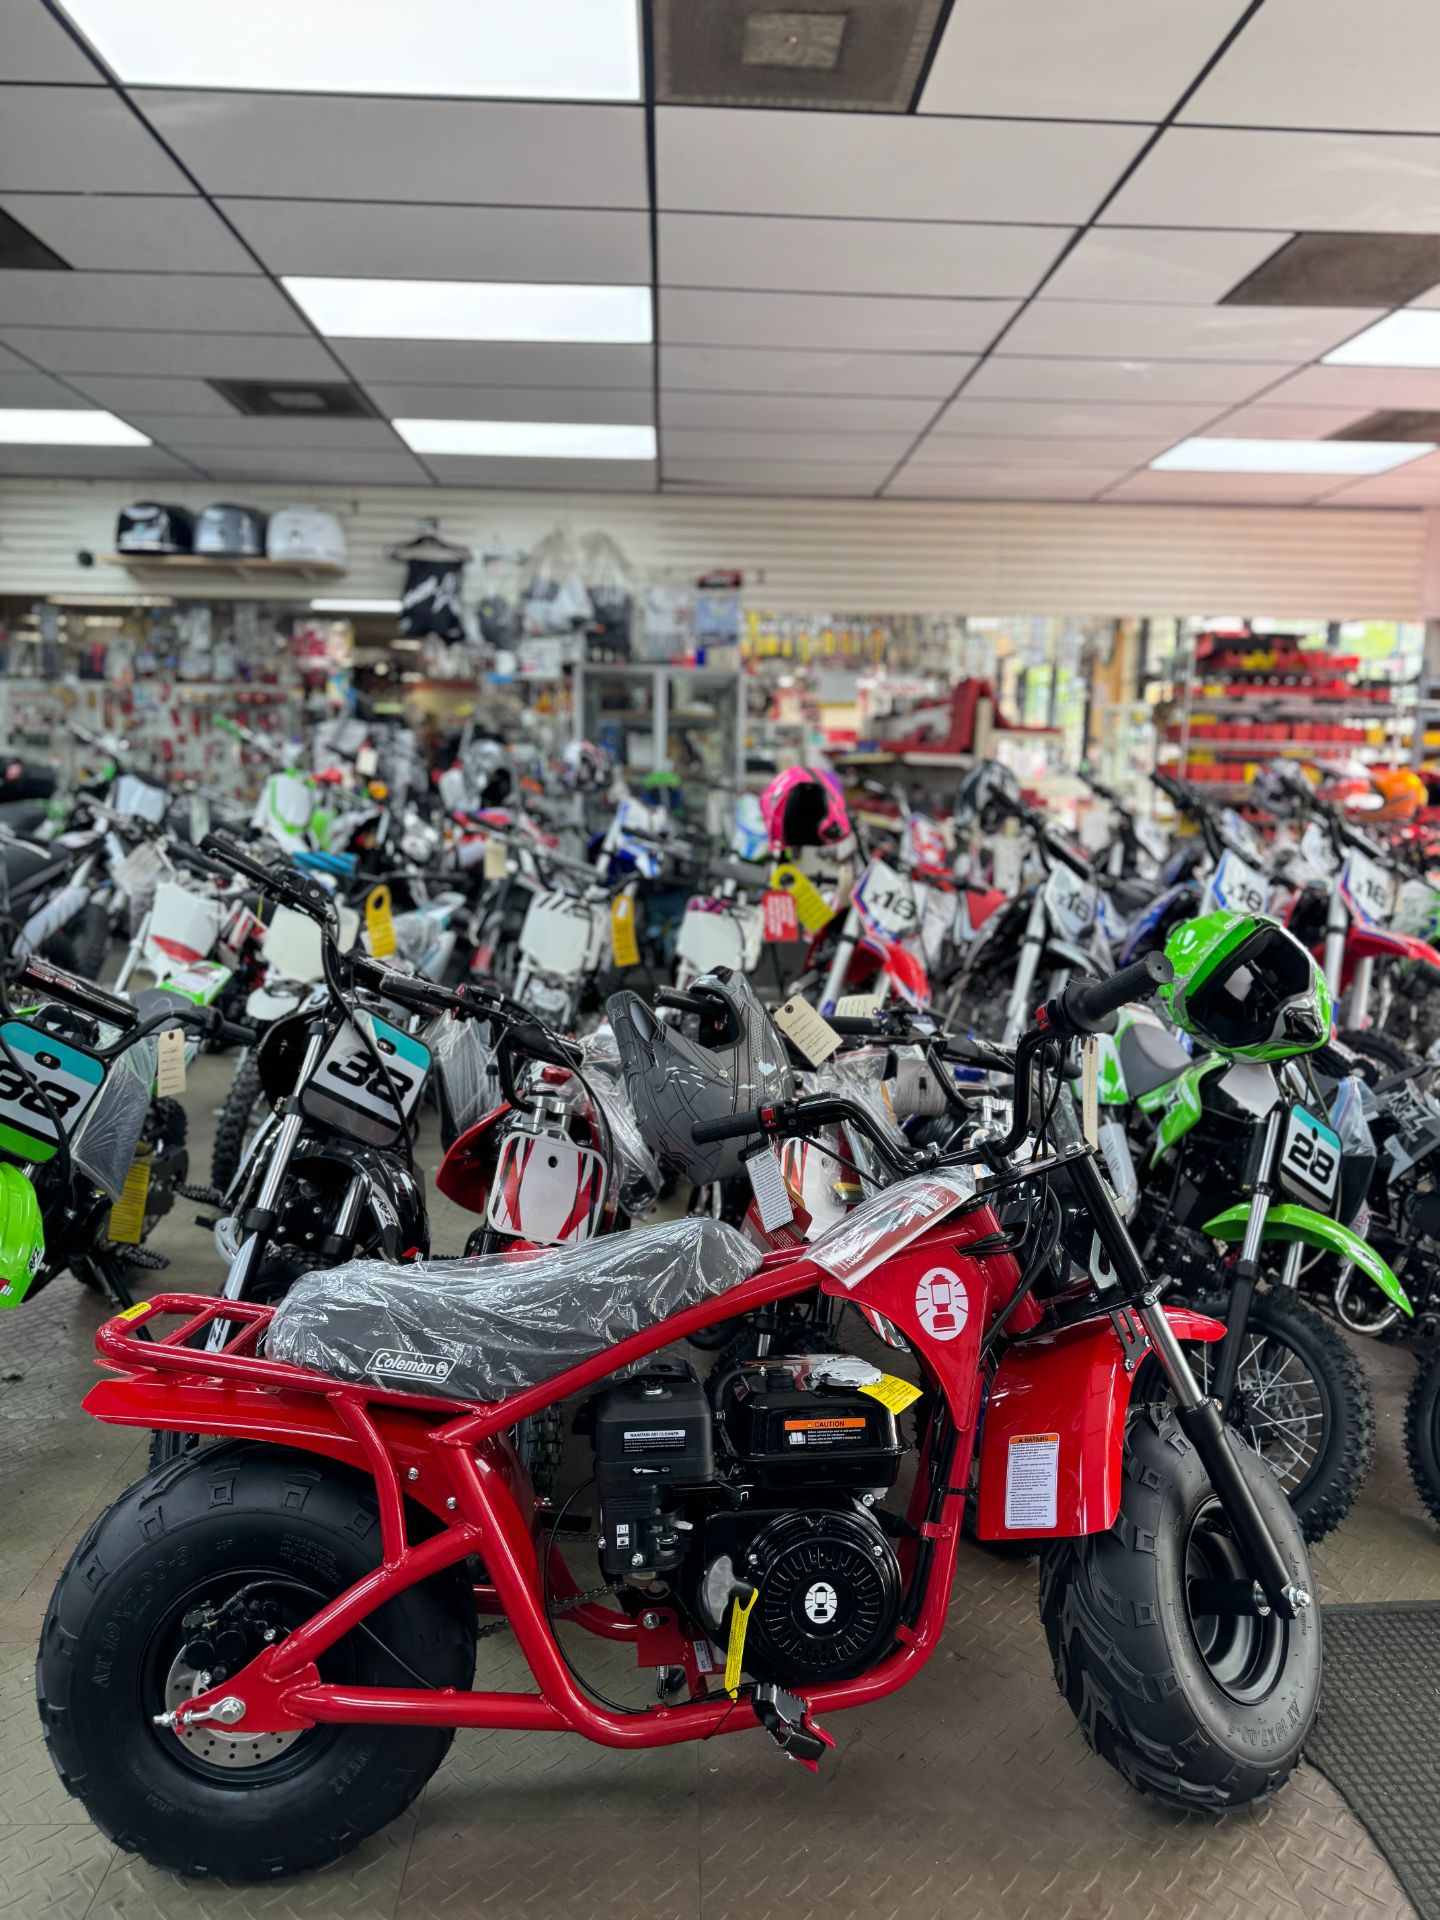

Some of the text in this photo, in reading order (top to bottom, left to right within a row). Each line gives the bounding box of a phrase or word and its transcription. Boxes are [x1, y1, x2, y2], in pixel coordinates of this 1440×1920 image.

[326, 1050, 414, 1111] 38
[1288, 1132, 1335, 1185] 28
[375, 1353, 435, 1374] Coleman
